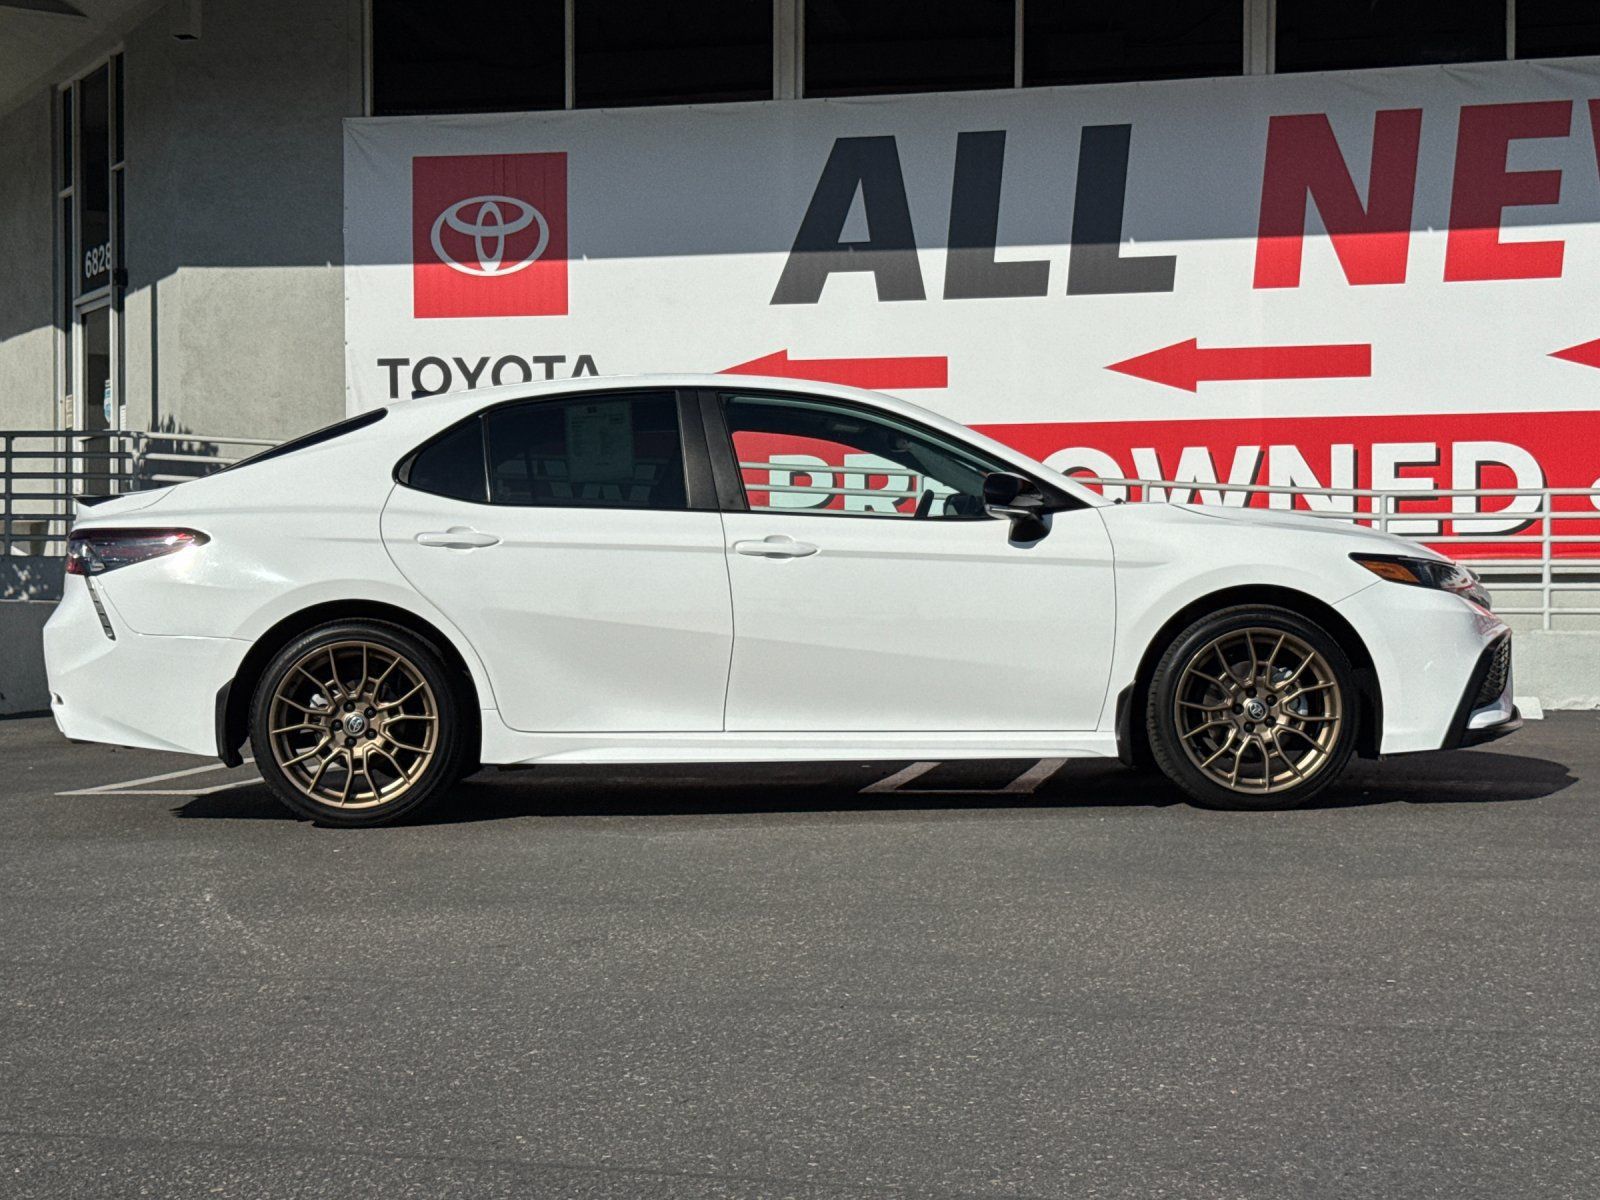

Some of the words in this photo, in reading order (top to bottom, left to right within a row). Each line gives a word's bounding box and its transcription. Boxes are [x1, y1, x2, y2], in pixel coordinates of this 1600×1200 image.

[85, 241, 111, 279] 6828
[769, 124, 1176, 305] ALL
[1253, 99, 1600, 289] NE
